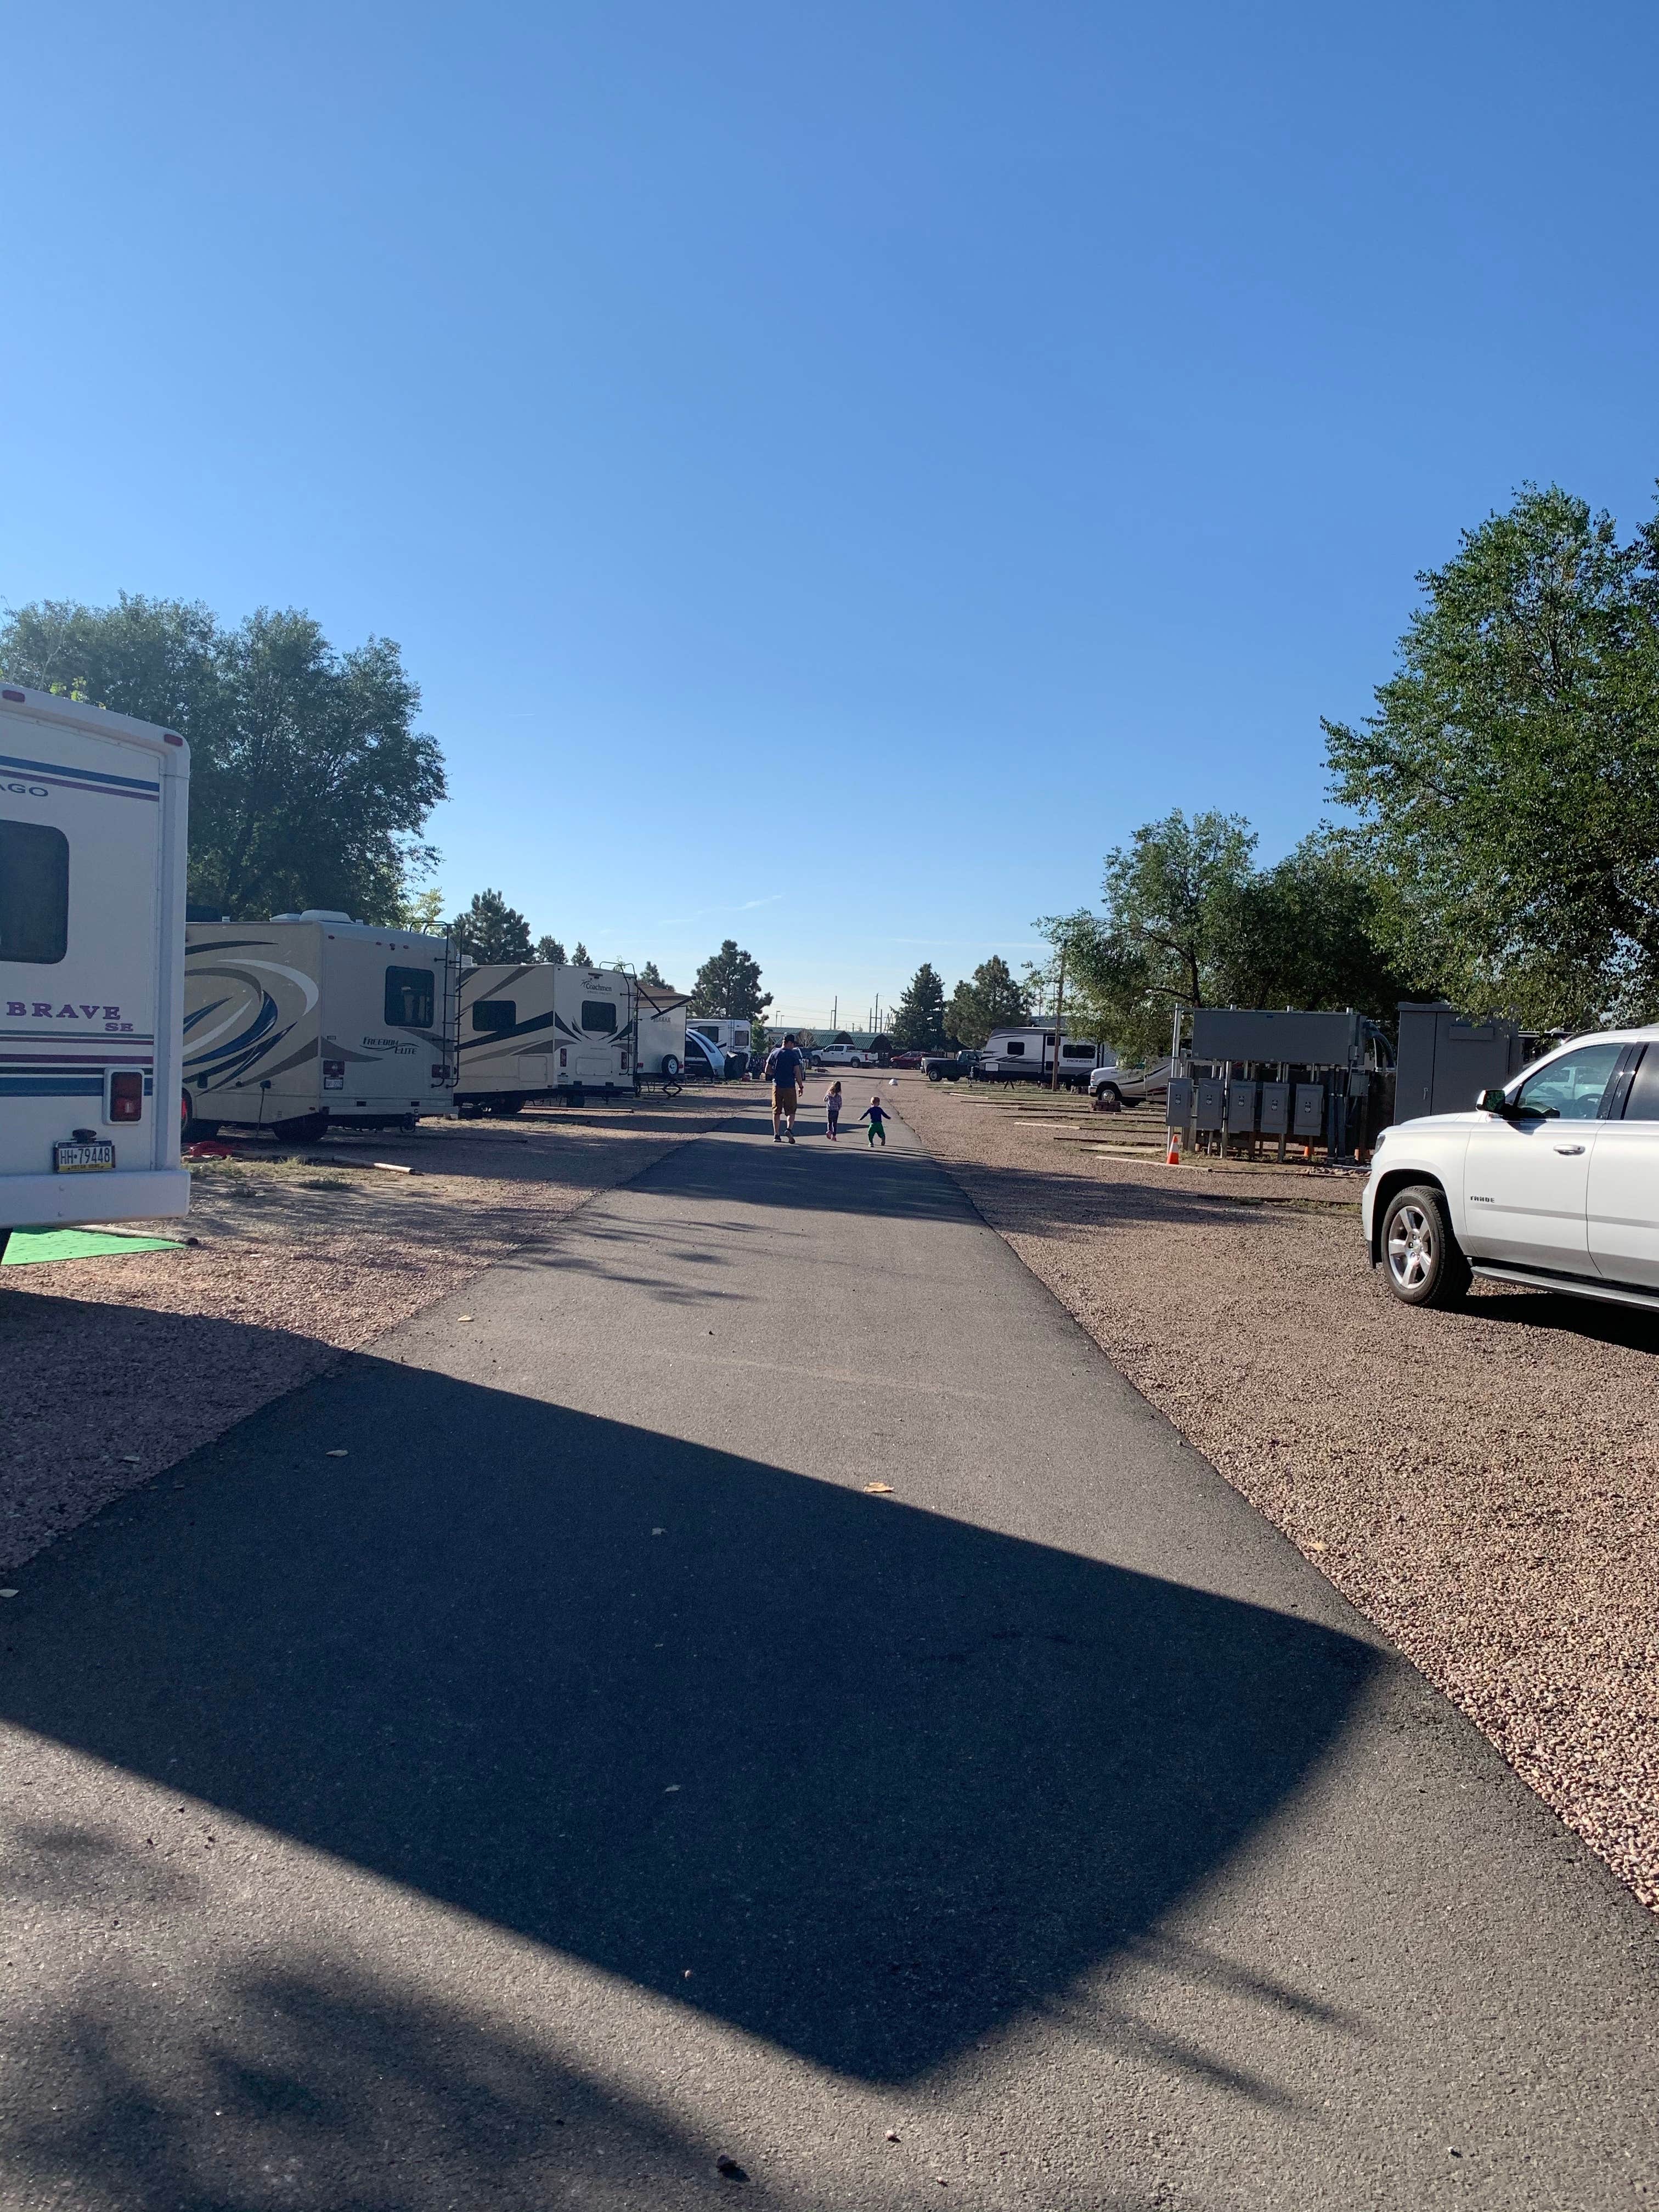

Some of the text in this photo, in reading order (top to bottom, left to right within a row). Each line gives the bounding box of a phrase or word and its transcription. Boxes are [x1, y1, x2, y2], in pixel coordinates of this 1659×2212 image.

[586, 983, 612, 991] Coachmen
[6, 1001, 121, 1020] BRAVE
[105, 1022, 134, 1032] SE
